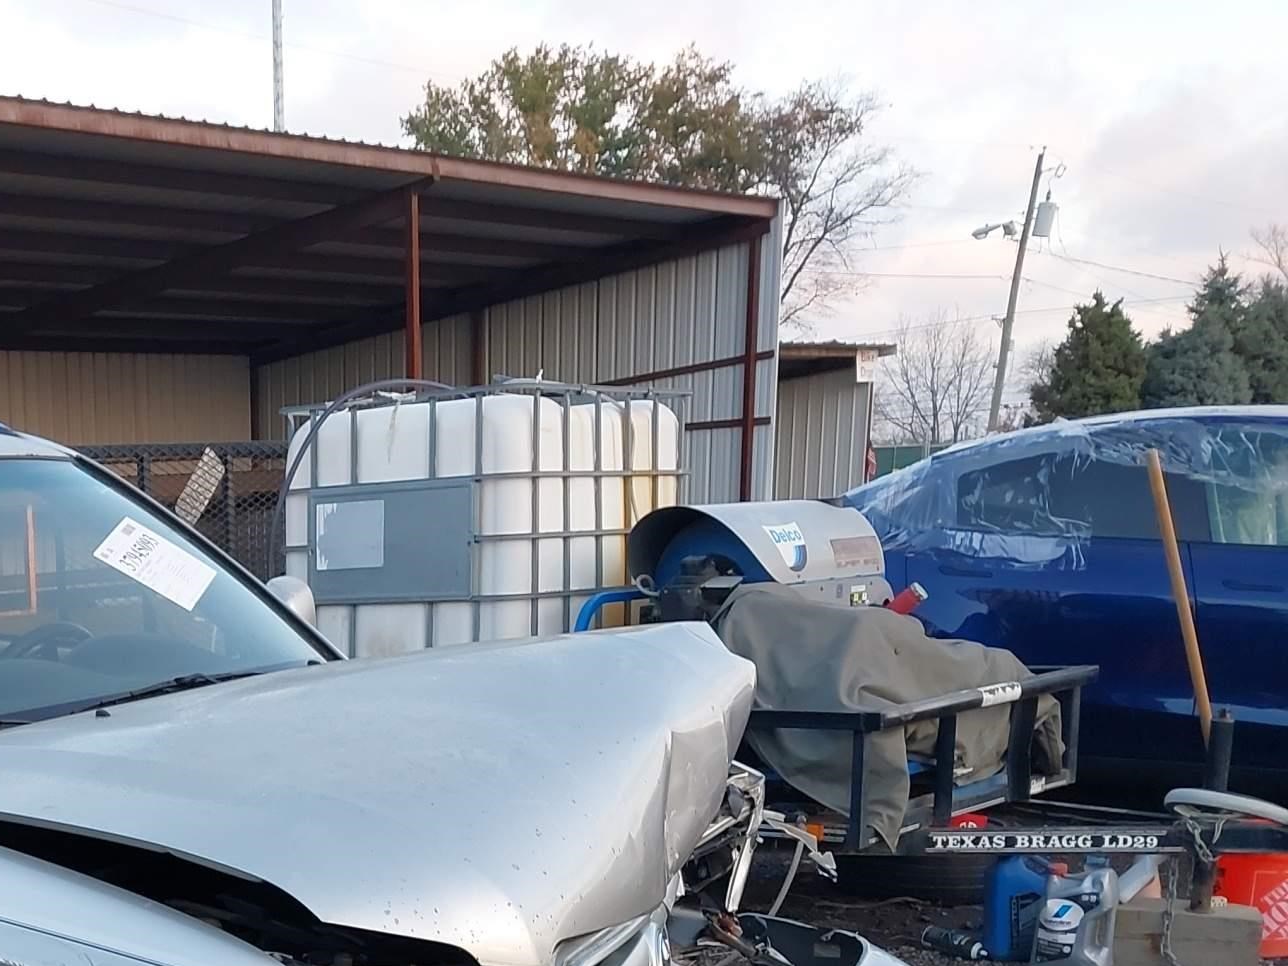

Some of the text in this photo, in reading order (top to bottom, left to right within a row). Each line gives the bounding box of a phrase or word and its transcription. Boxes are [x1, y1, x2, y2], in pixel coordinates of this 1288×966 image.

[769, 528, 802, 544] Delco
[932, 834, 1159, 849] TEXAS BRAGG LD29
